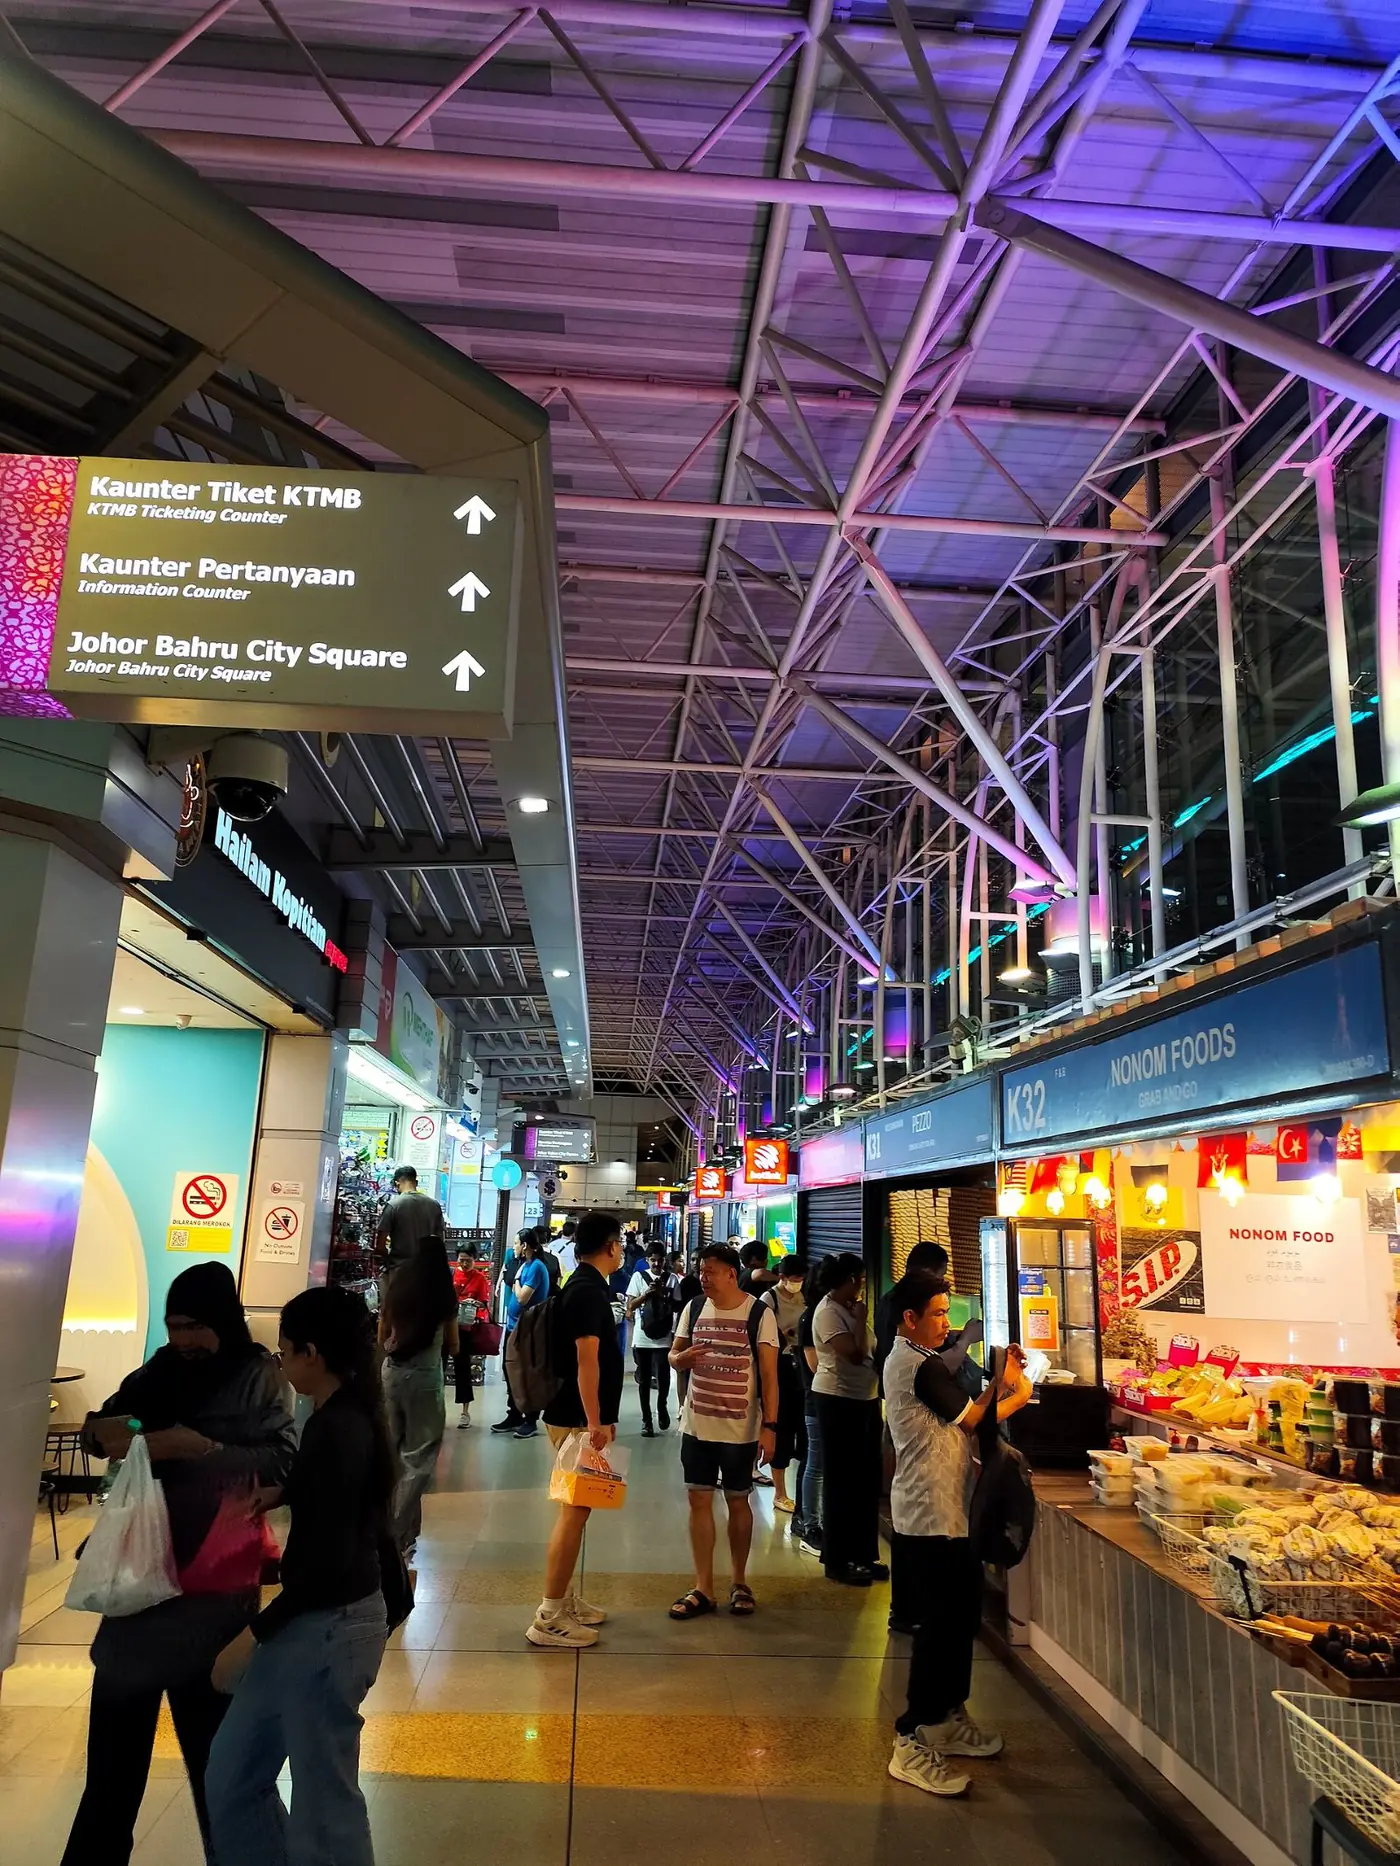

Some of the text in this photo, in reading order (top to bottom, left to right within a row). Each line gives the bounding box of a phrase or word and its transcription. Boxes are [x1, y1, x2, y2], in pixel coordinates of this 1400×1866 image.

[90, 476, 362, 510] Kaunter Tiket KTMB
[87, 503, 287, 525] KTMB Ticketing Counter
[79, 553, 355, 588] Kaunter Pertanyaan
[77, 580, 250, 600] Information Counter
[67, 631, 408, 669] Johor Bahru City Square
[65, 659, 271, 682] Johor Bahru City Square
[214, 806, 271, 897] Hailam
[271, 869, 326, 952] Kopitiam
[1111, 1023, 1237, 1087] NONOM FOODS
[1008, 1079, 1046, 1134] K32
[1138, 1091, 1162, 1108] GRAB
[1183, 1081, 1198, 1099] GO
[911, 1110, 932, 1134] PEZZO
[866, 1132, 881, 1160] K31
[1229, 1228, 1334, 1243] NONOM FOOD
